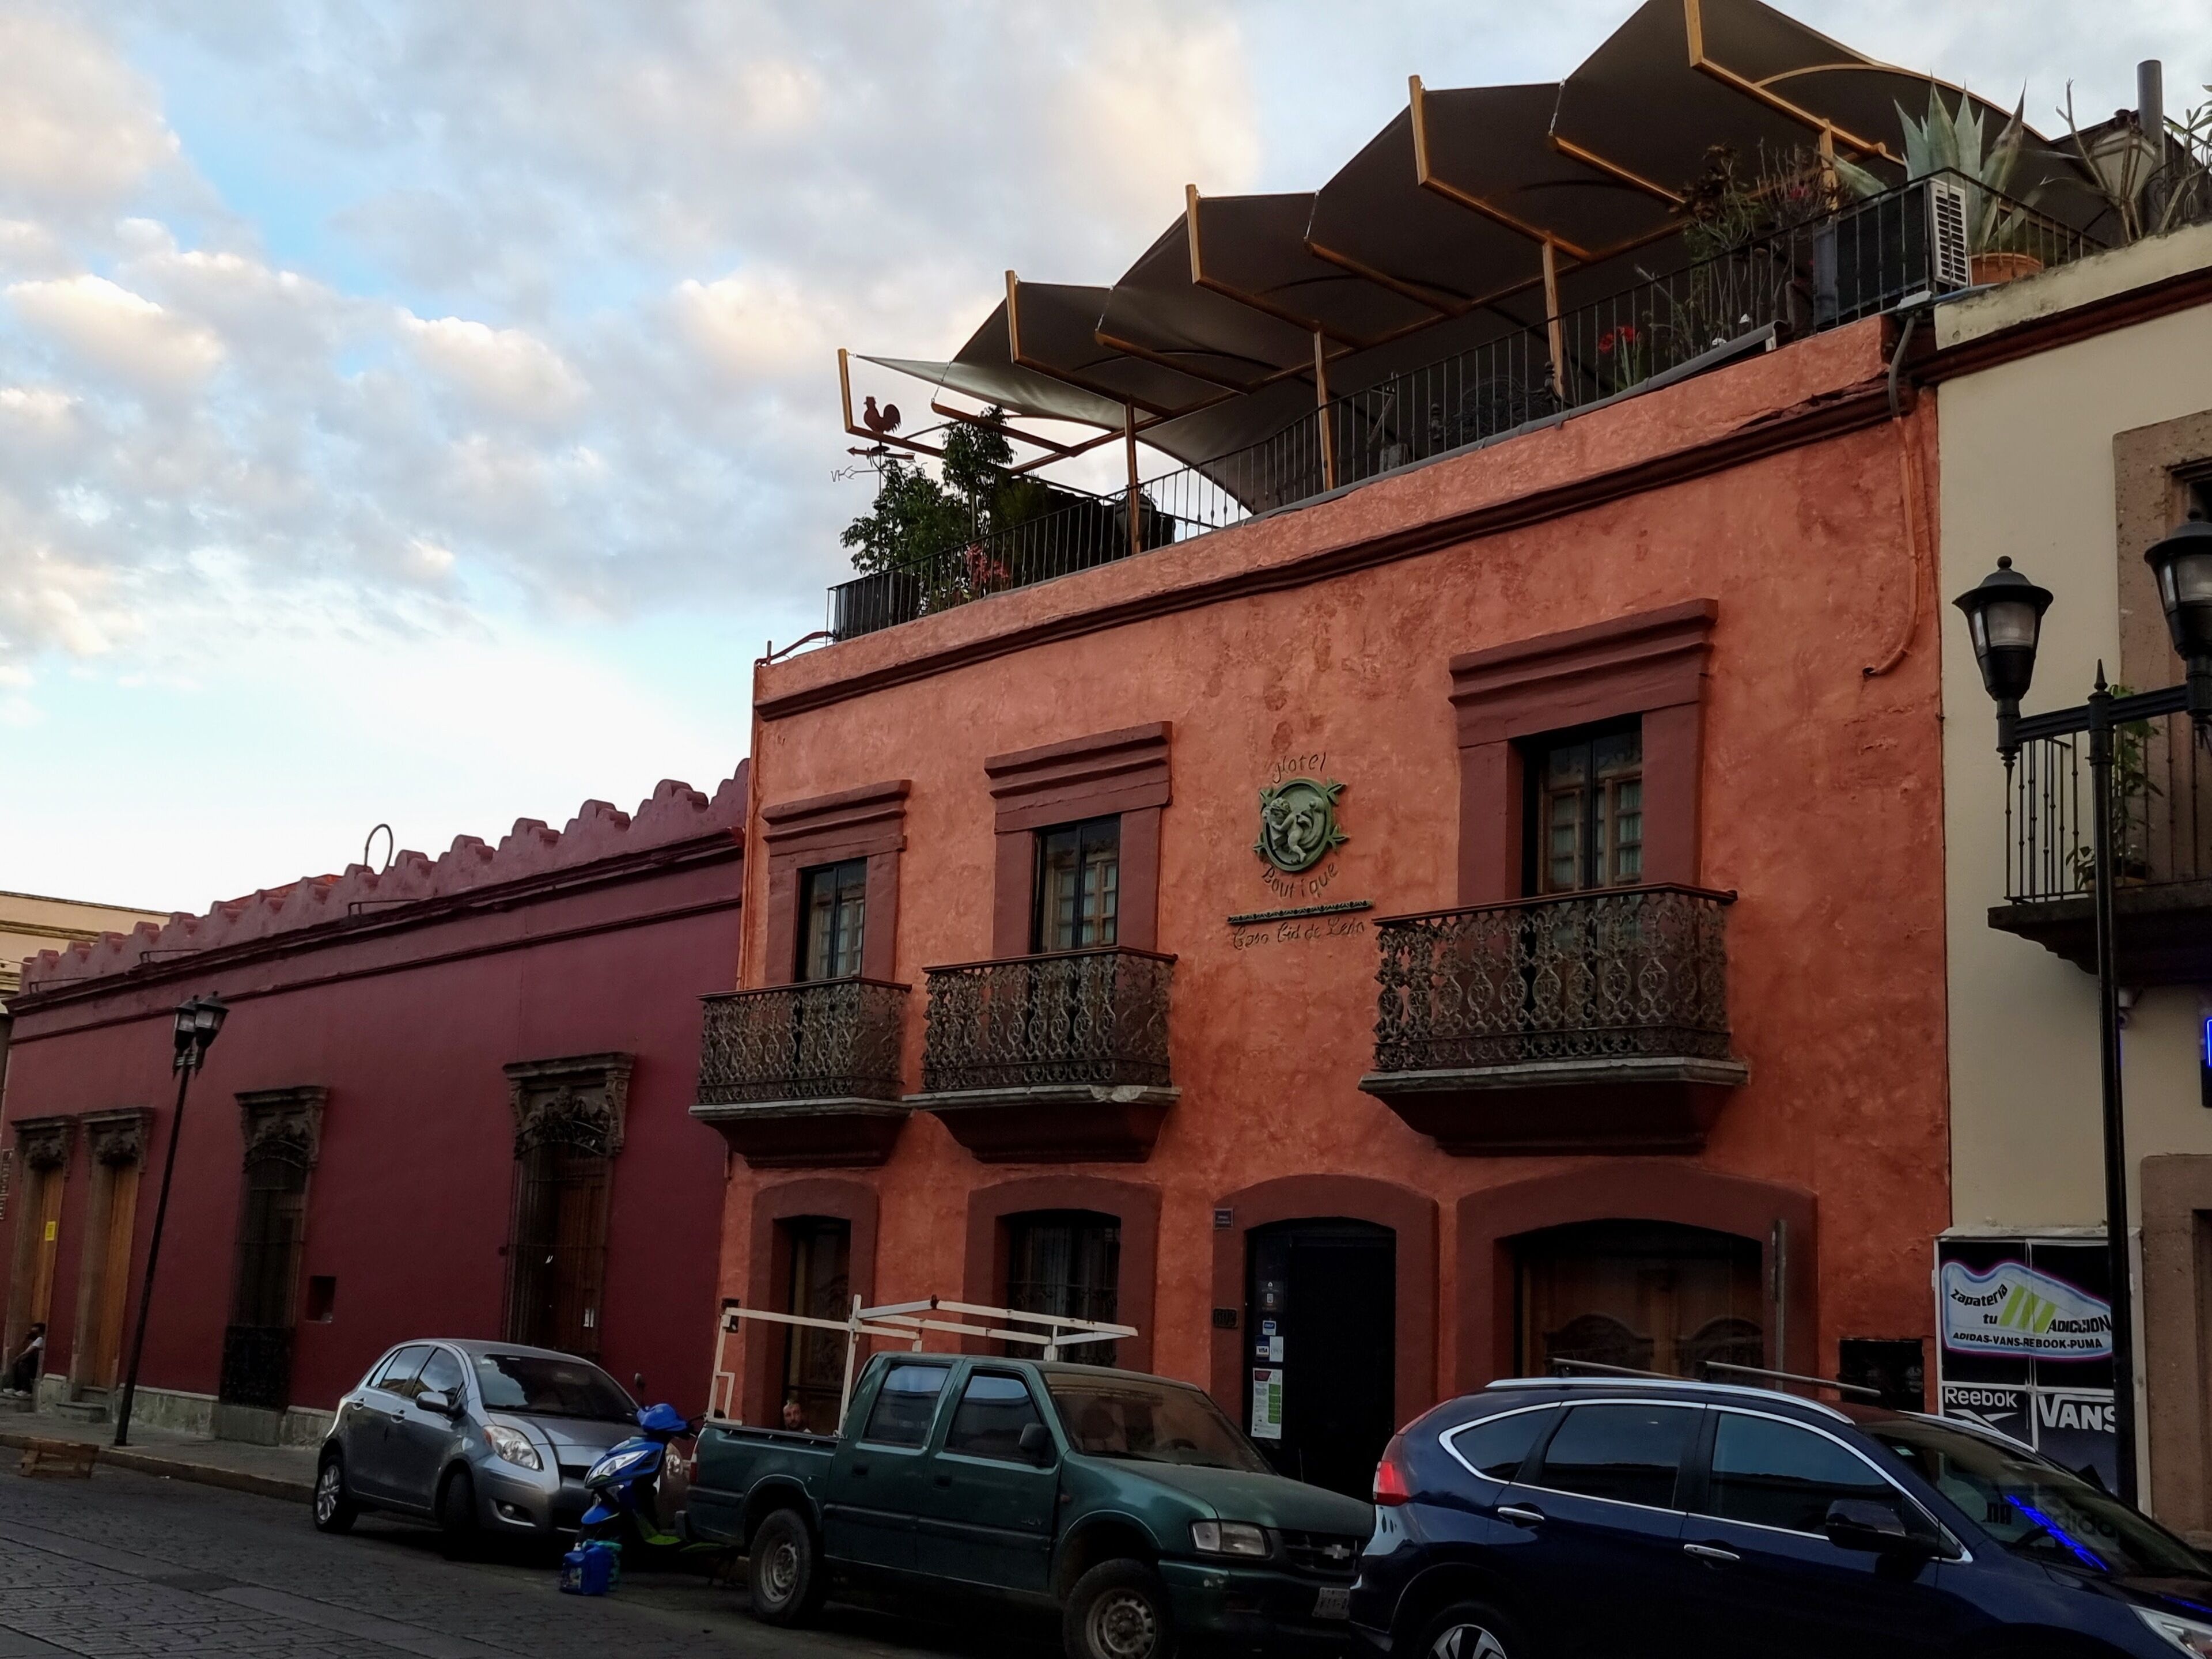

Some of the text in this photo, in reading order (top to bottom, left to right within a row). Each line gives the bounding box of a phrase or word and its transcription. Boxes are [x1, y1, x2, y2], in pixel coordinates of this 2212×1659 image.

[1271, 752, 1326, 784] Hotel
[1262, 862, 1339, 899] Boutique
[1277, 922, 1301, 943] Cid
[1304, 923, 1321, 941] de
[1983, 1313, 1998, 1325] tu
[1945, 1387, 2018, 1408] Reebok
[2037, 1393, 2115, 1433] VANS
